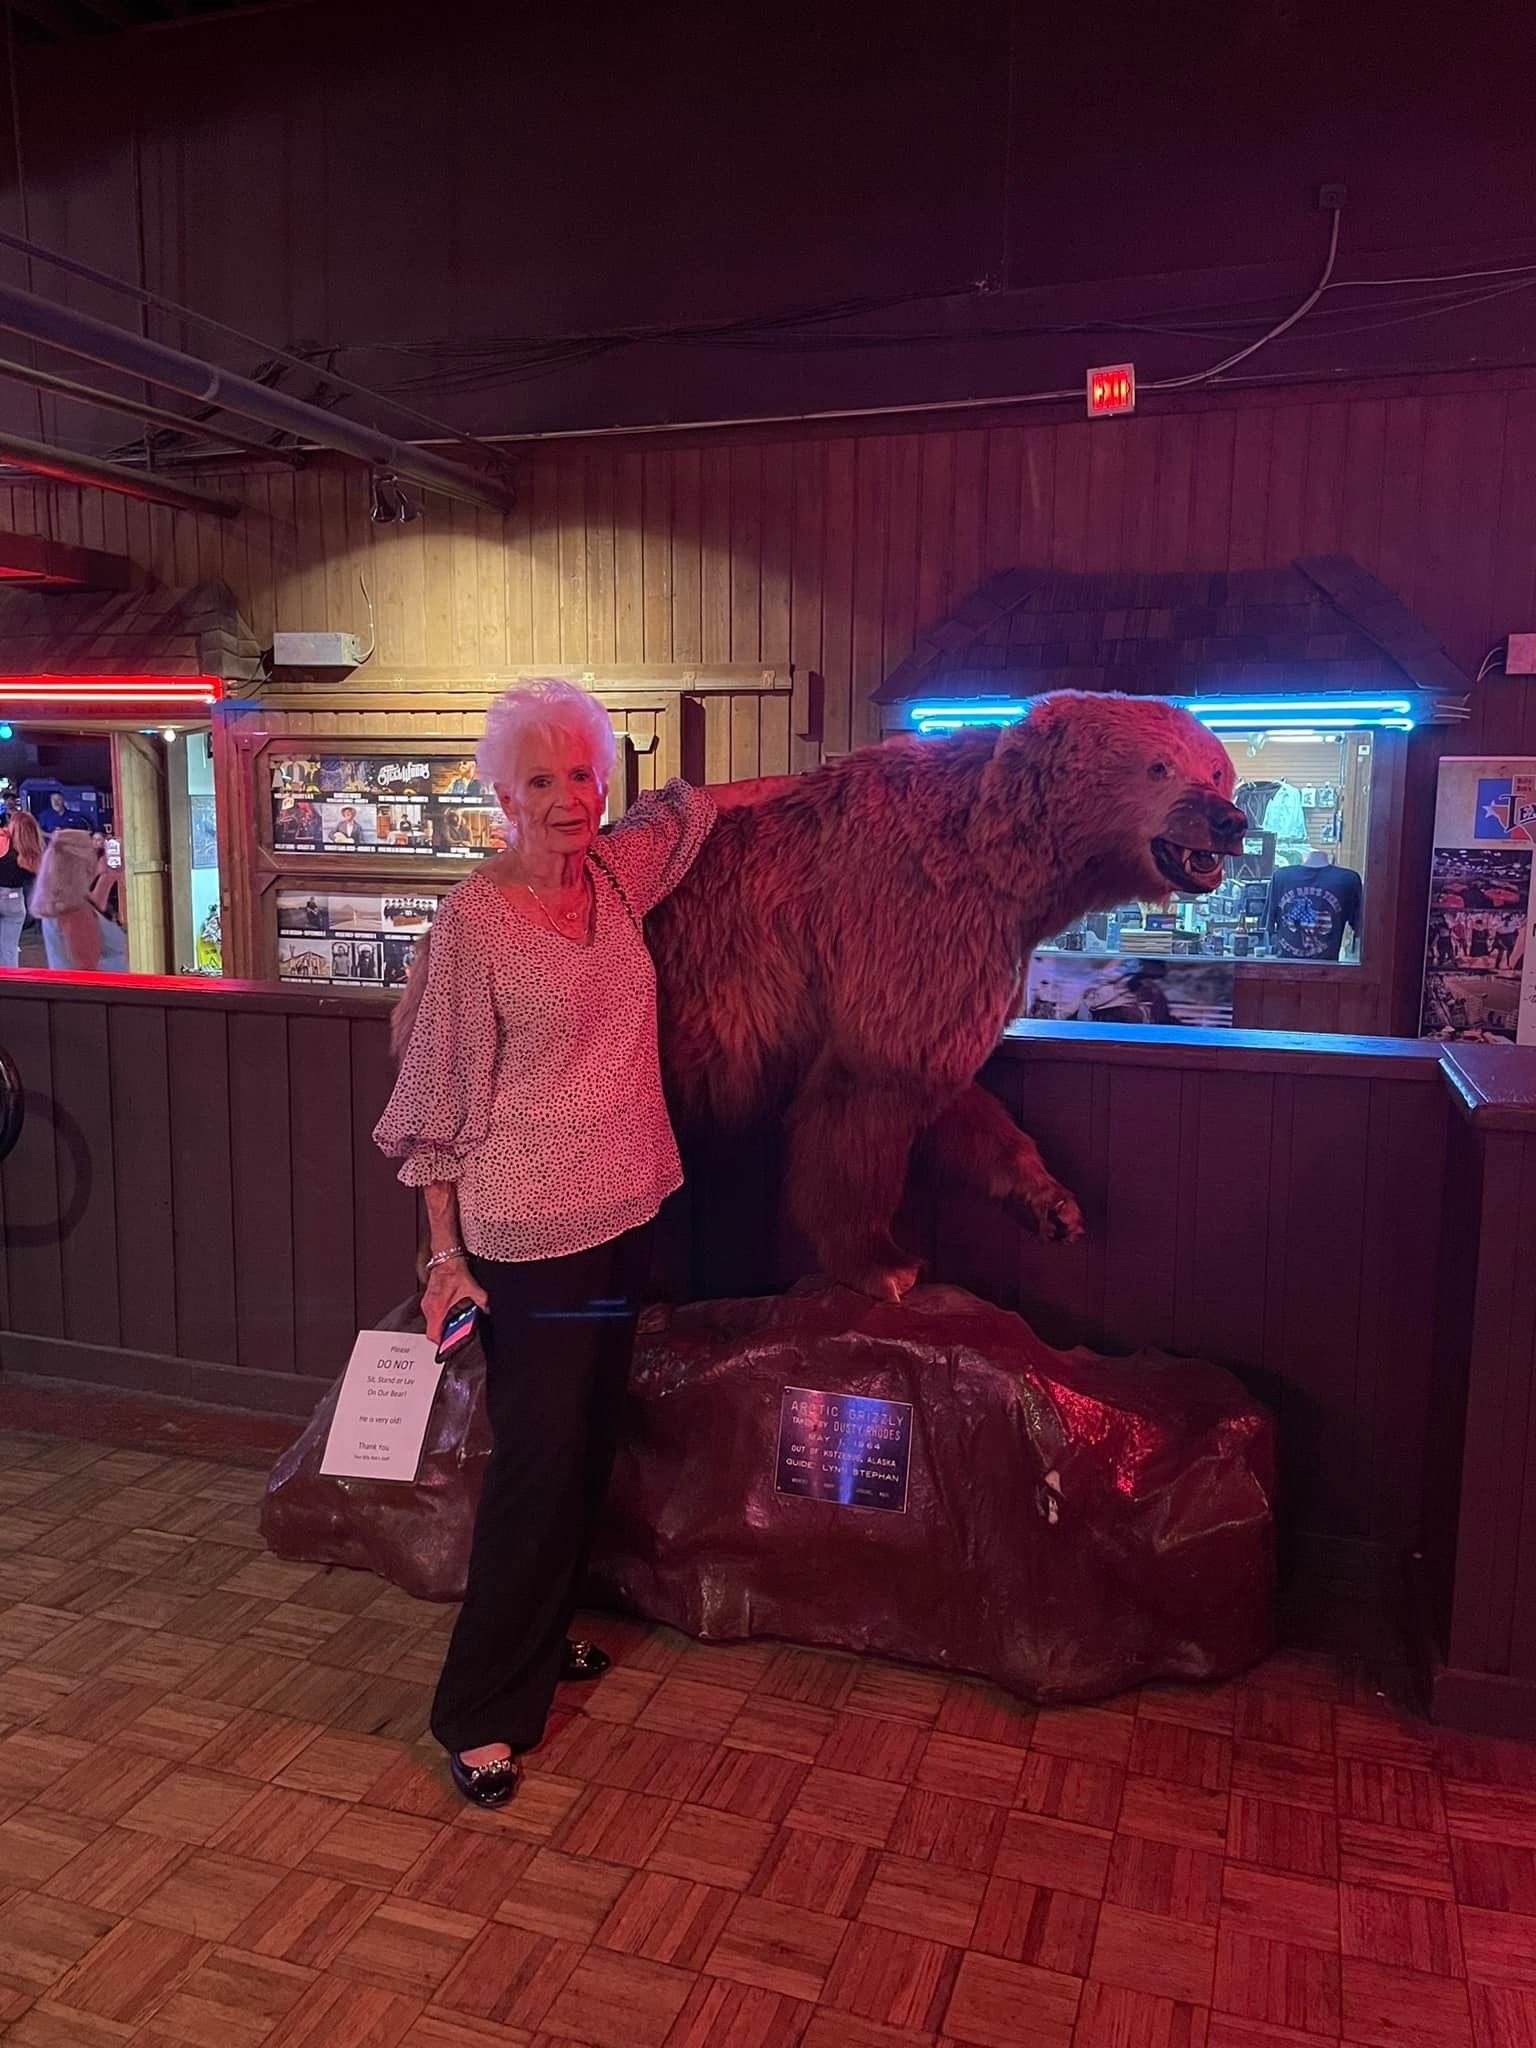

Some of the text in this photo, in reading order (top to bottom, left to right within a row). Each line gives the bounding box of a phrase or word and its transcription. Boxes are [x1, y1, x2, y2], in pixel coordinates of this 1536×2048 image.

[1094, 369, 1129, 409] EXIT
[390, 1346, 410, 1354] Please
[376, 1359, 415, 1371] DO NOT
[377, 1376, 396, 1384] Stand
[404, 1377, 415, 1386] Lay
[367, 1389, 408, 1399] On Our Bear!
[791, 1400, 904, 1427] ARCTIC GRIZZLY
[359, 1415, 369, 1423] He
[375, 1417, 388, 1425] very
[833, 1420, 863, 1434] DUSTY
[808, 1433, 831, 1441] MAY
[359, 1441, 390, 1452] Thank You
[791, 1444, 806, 1453] OUT
[809, 1447, 819, 1455] OF
[867, 1456, 897, 1467] ALASKA
[785, 1458, 816, 1469] GUIDE
[852, 1468, 900, 1483] STEPHAN
